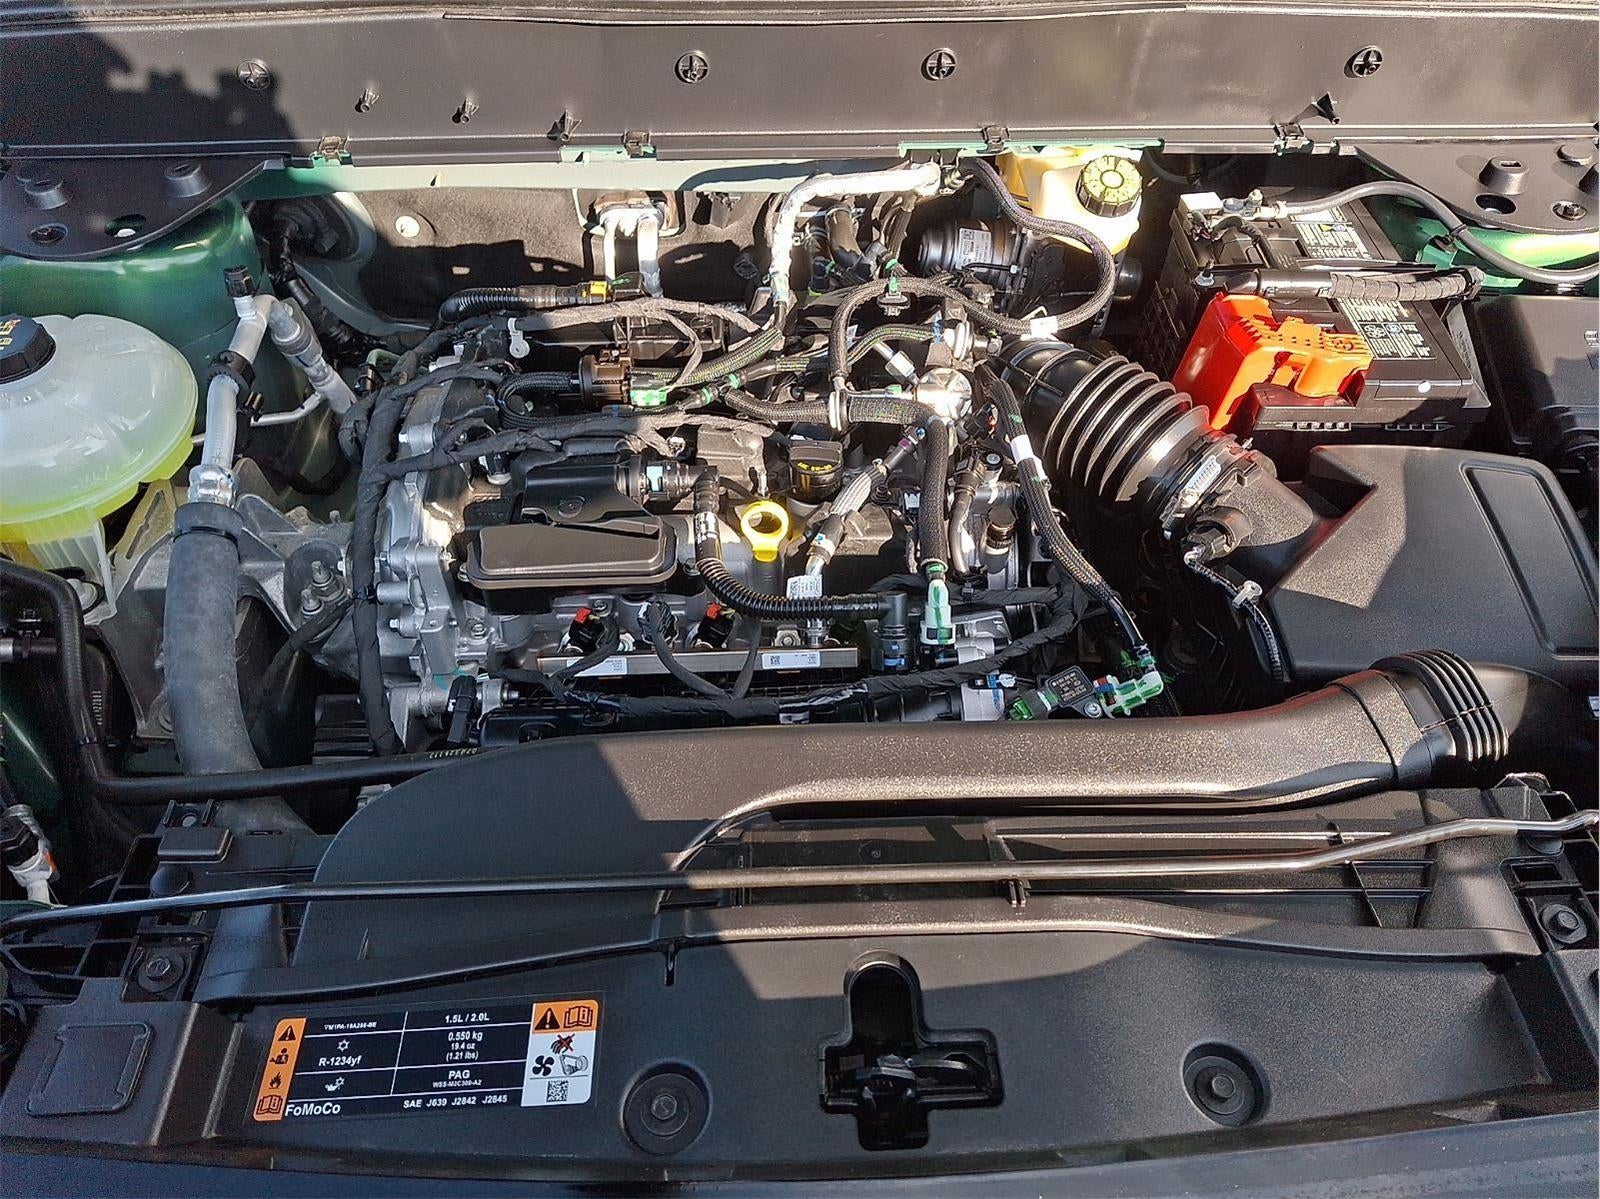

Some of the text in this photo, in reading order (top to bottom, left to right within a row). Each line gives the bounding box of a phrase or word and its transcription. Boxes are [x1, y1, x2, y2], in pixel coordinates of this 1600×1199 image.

[445, 1014, 463, 1023] 1.5L
[471, 1012, 490, 1022] 2.0L
[448, 1030, 483, 1041] 0.550 kg
[451, 1042, 465, 1050] 19.4
[318, 1055, 362, 1067] R-1234yf
[446, 1051, 479, 1061] (1.21 lbs)
[448, 1070, 470, 1080] PAG
[403, 1099, 422, 1108] SAE
[426, 1098, 447, 1107] J639
[451, 1096, 477, 1106] J2842
[285, 1102, 341, 1117] FoMoCo
